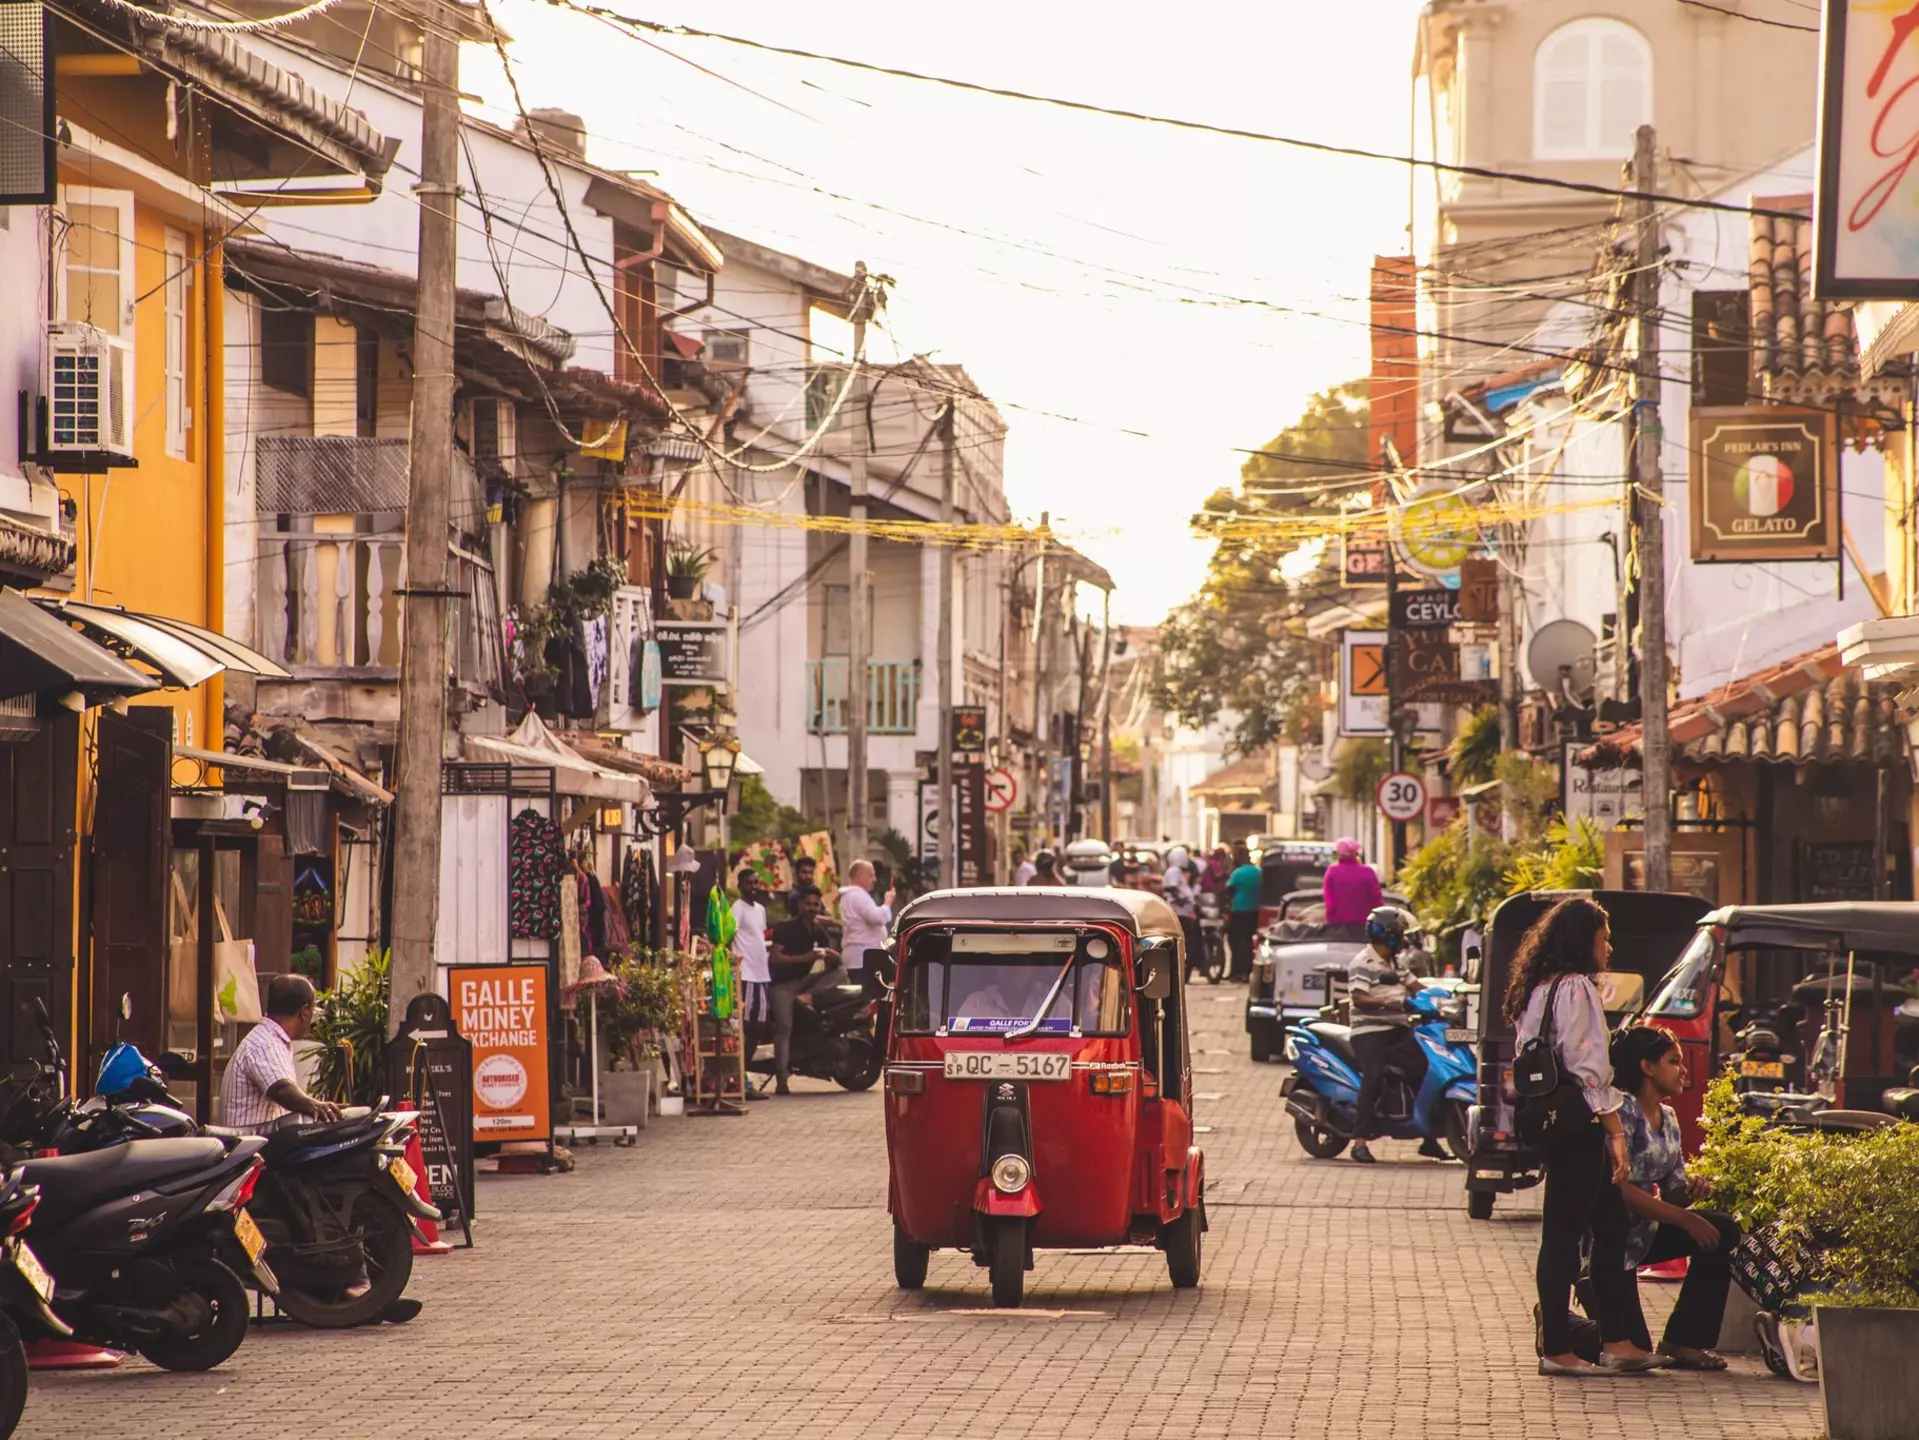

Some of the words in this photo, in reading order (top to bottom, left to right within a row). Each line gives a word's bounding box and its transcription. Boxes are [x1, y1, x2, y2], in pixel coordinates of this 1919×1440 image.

[1724, 441, 1778, 452] PEDLAR'S
[1781, 441, 1801, 451] INN
[1731, 518, 1797, 532] GELATO
[1388, 782, 1417, 803] 30
[461, 979, 536, 1007] GALLE
[462, 1006, 535, 1031] MONEY
[462, 1030, 537, 1048] EXCHANGE
[946, 1064, 963, 1076] SP
